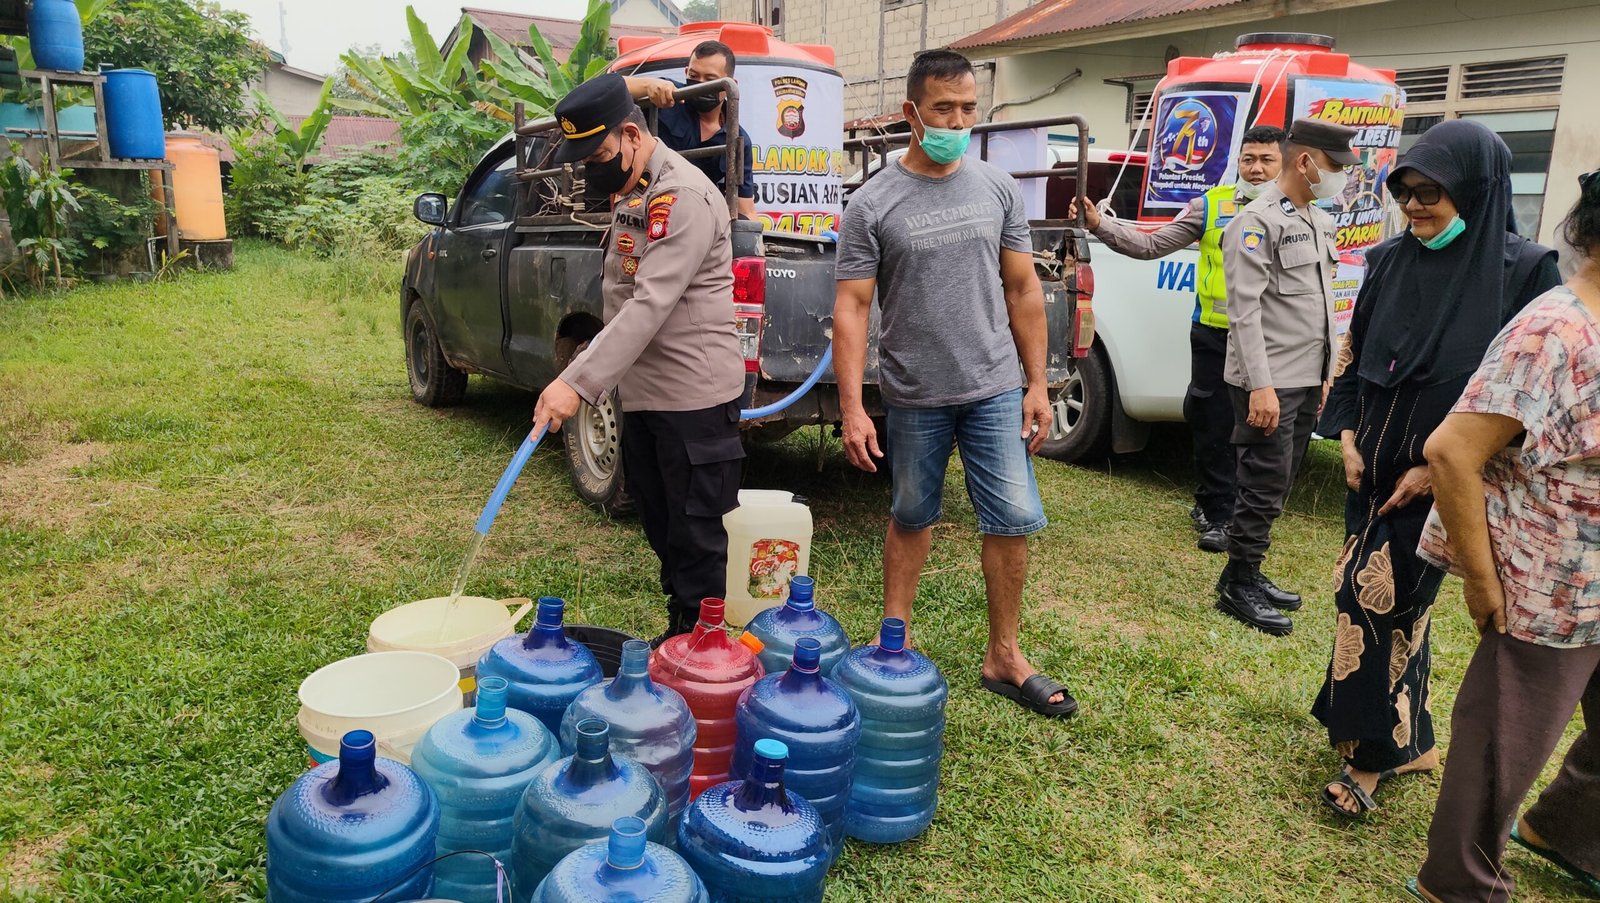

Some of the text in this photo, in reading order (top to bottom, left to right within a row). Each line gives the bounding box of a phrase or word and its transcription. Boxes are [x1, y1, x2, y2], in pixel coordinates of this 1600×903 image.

[1320, 101, 1388, 125] BANTUAN
[752, 146, 829, 173] LANDAK
[616, 212, 645, 229] POLRI
[911, 226, 995, 251] FREE YOUR NATURE
[766, 268, 797, 279] TOYO
[1157, 260, 1196, 293] WA
